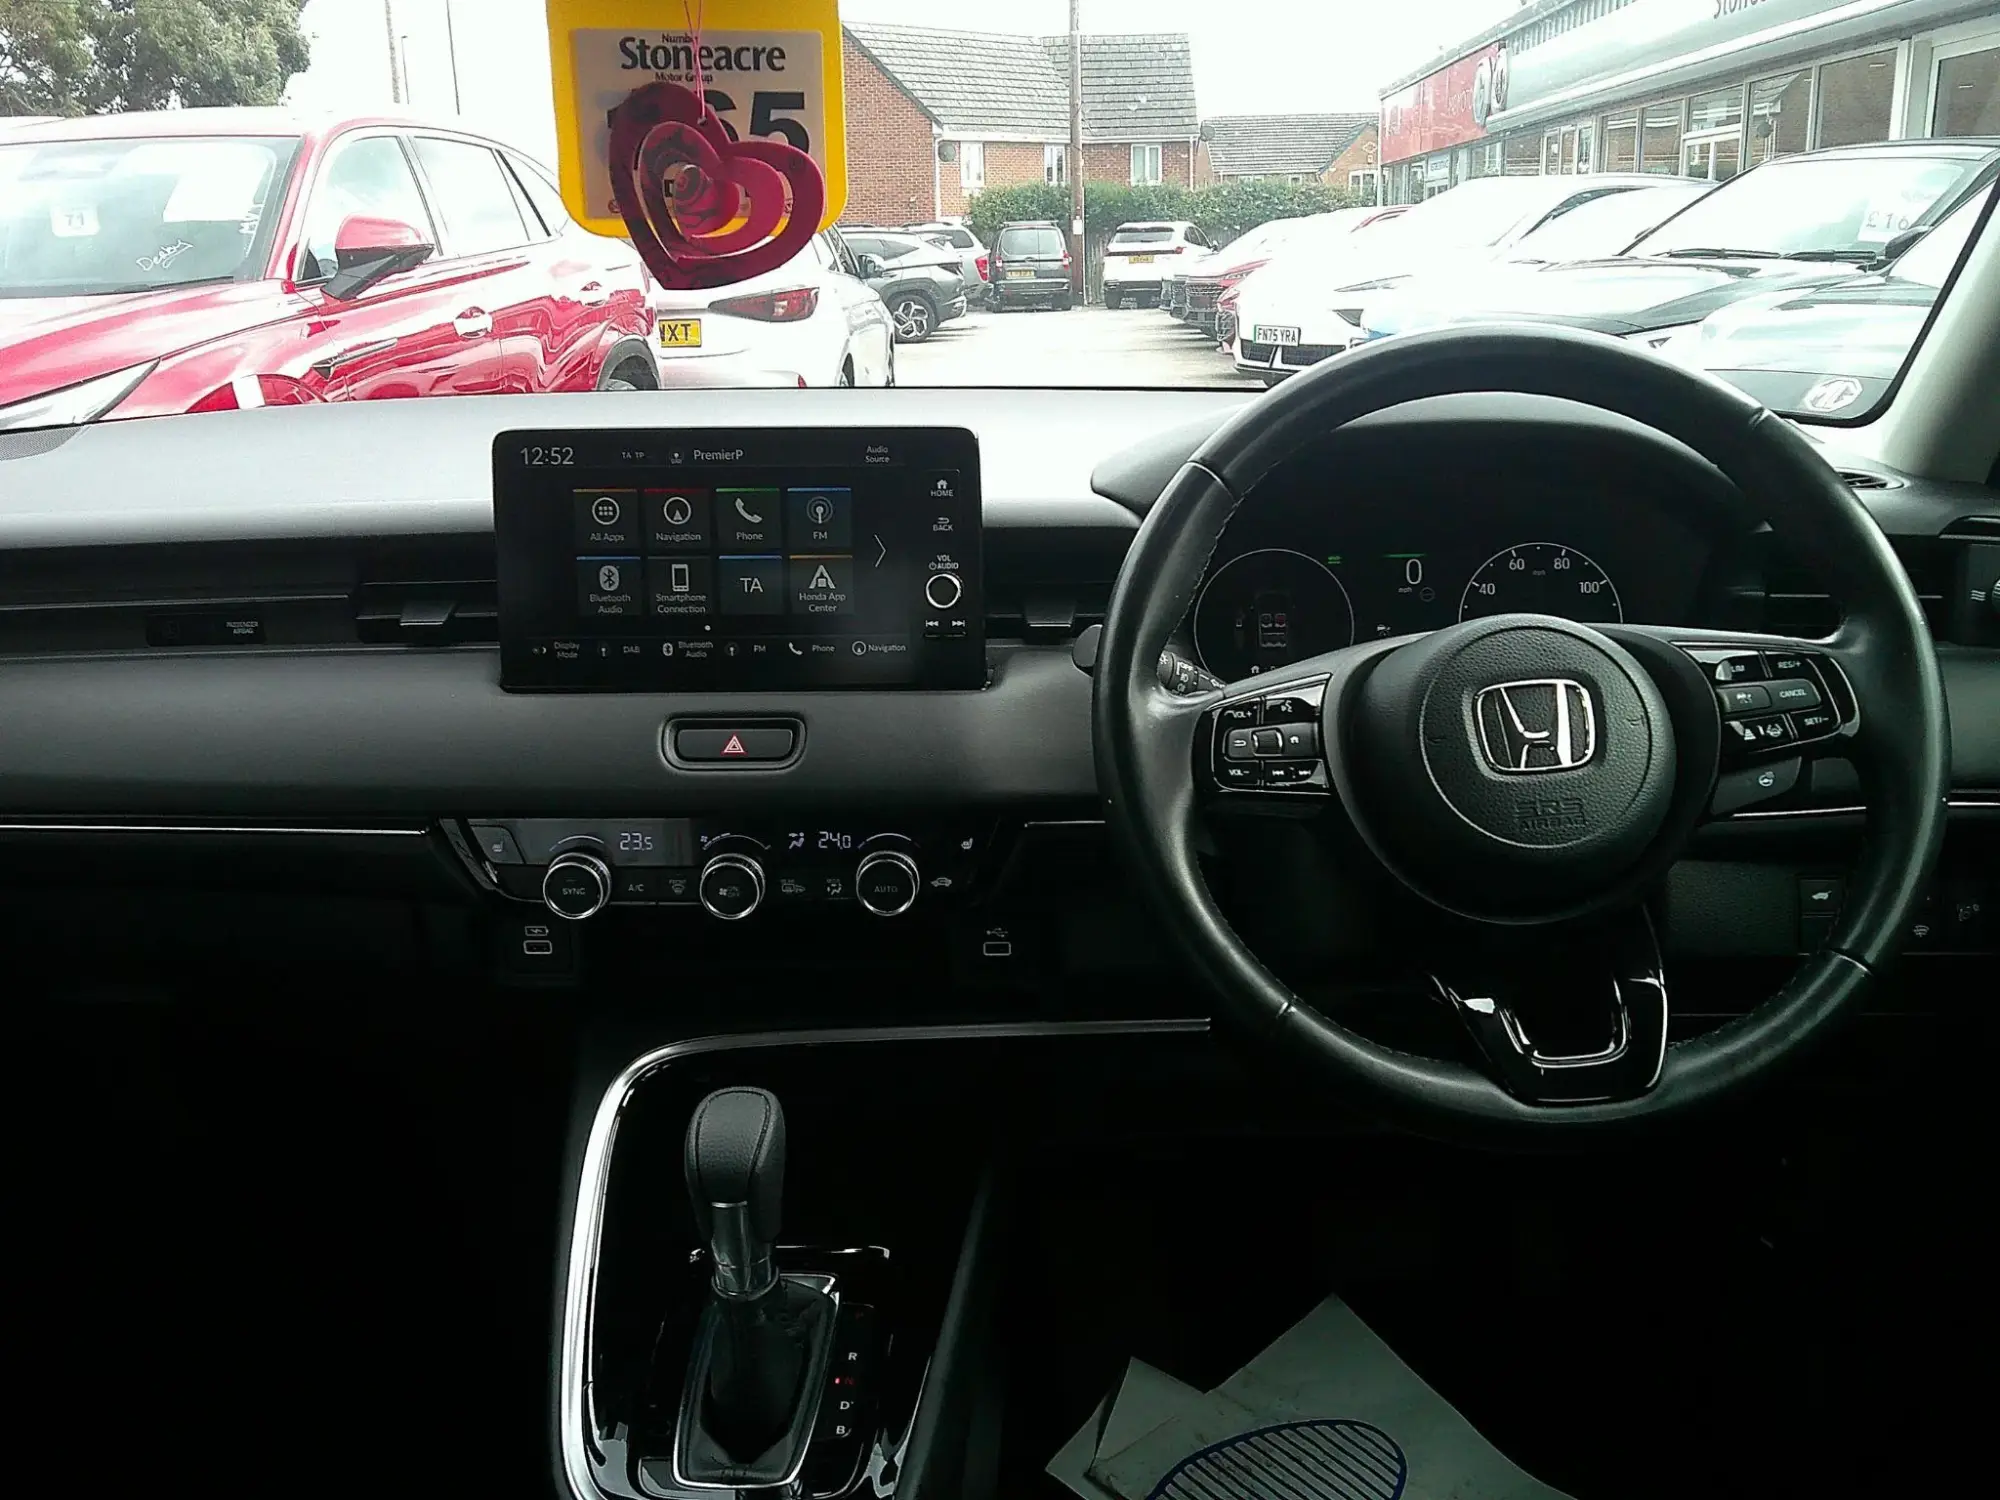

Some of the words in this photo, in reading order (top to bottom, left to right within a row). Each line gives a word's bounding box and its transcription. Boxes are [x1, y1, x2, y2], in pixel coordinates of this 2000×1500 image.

[618, 36, 786, 71] Stoneacre
[655, 72, 682, 82] Motor
[1257, 328, 1279, 341] FN75
[1280, 329, 1297, 343] YRA
[866, 445, 889, 453] Audio
[520, 447, 575, 465] 12:52
[693, 449, 744, 461] PremierP
[865, 455, 890, 463] Source
[930, 489, 954, 497] HOME
[604, 532, 625, 542] Apps
[655, 532, 701, 542] Navigation
[736, 531, 764, 540] Phone
[812, 531, 828, 540] FM
[1509, 558, 1525, 570] 60
[1553, 557, 1570, 570] 80
[1406, 558, 1422, 584] 0
[739, 577, 764, 593] TA
[1479, 582, 1496, 595] 40
[1579, 581, 1600, 593] 100
[589, 593, 631, 602] Bluetooth
[655, 593, 707, 604] Smartphone
[799, 592, 827, 601] Honda
[828, 592, 846, 602] App
[598, 605, 623, 613] Audio
[657, 604, 706, 613] Connection
[808, 604, 837, 612] Center
[554, 641, 580, 651] Display
[678, 641, 713, 649] Bluetooth
[812, 644, 835, 652] Phone
[868, 644, 906, 653] Navigation
[557, 651, 578, 659] Mode
[685, 650, 708, 658] Audio
[1779, 688, 1807, 698] CANCEL
[817, 831, 851, 850] 24.0
[561, 887, 586, 896] SYNC
[628, 883, 645, 892] A/C
[874, 885, 899, 893] AUTO
[848, 1352, 858, 1361] R
[840, 1401, 851, 1410] D
[836, 1425, 846, 1435] B
